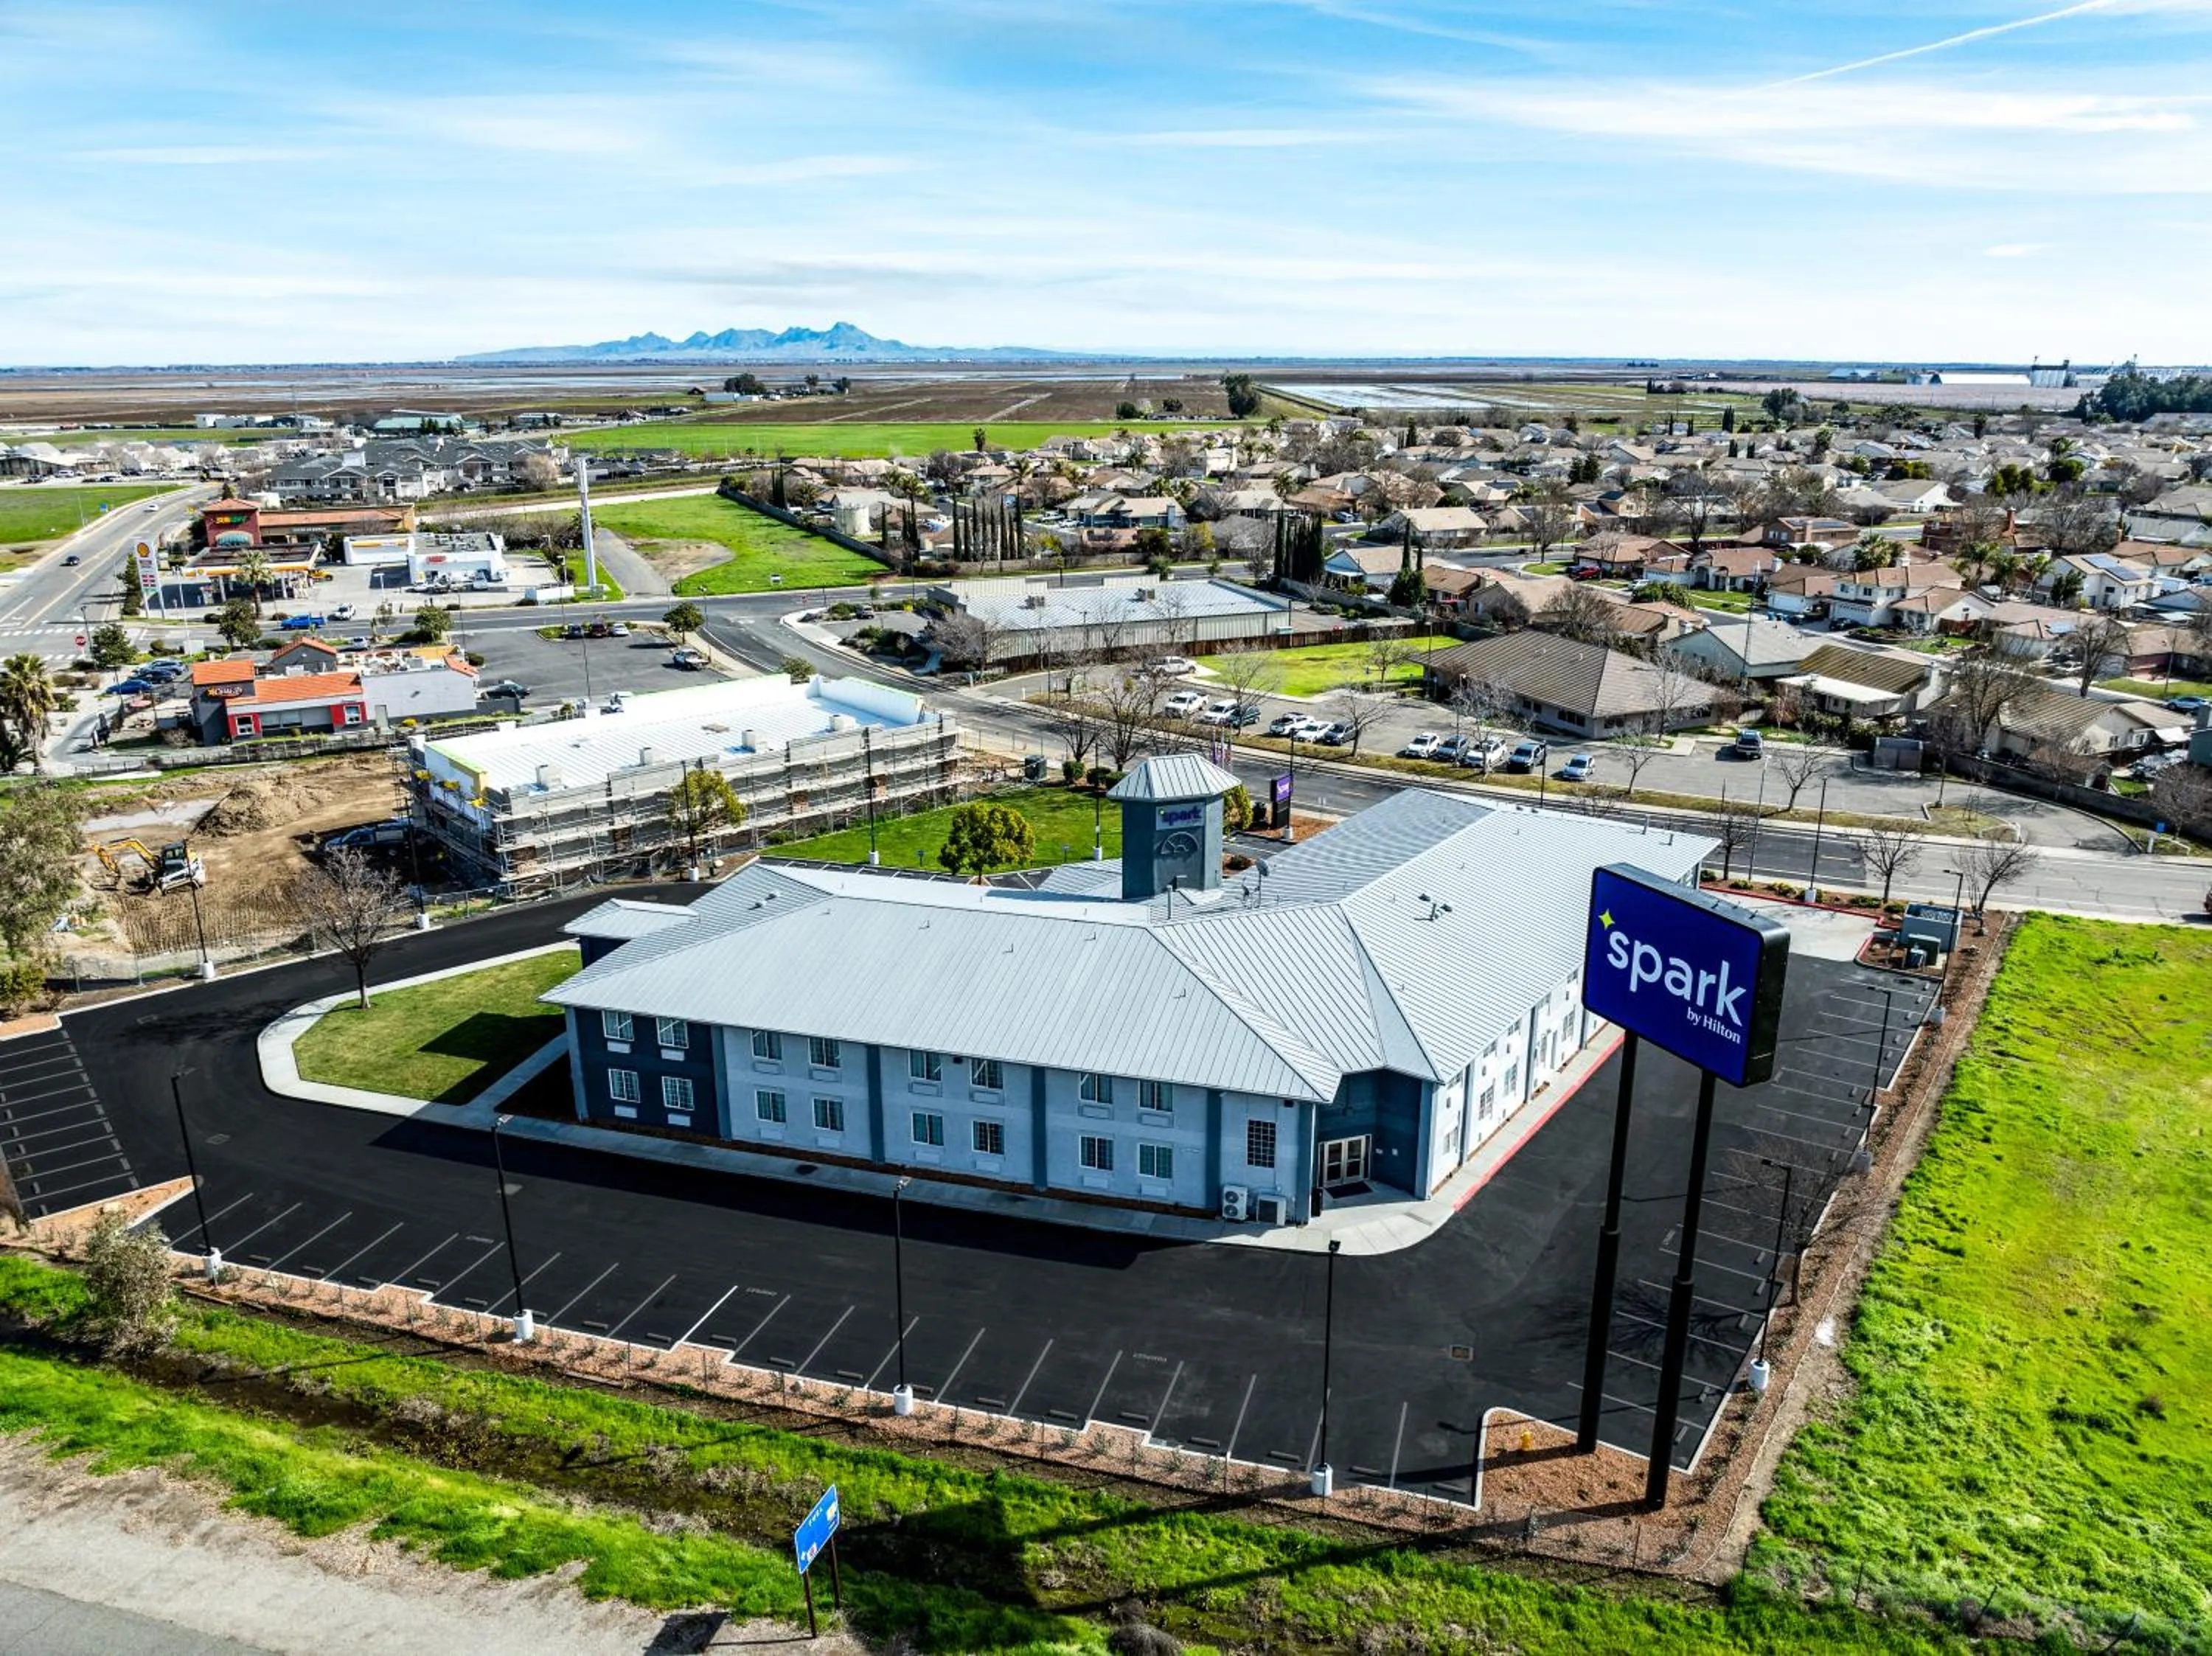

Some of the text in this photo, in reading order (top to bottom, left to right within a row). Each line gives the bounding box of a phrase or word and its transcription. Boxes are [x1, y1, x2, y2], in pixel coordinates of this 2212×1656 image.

[1607, 930, 1747, 1027] spark
[1686, 1006, 1742, 1044] by Hilton
